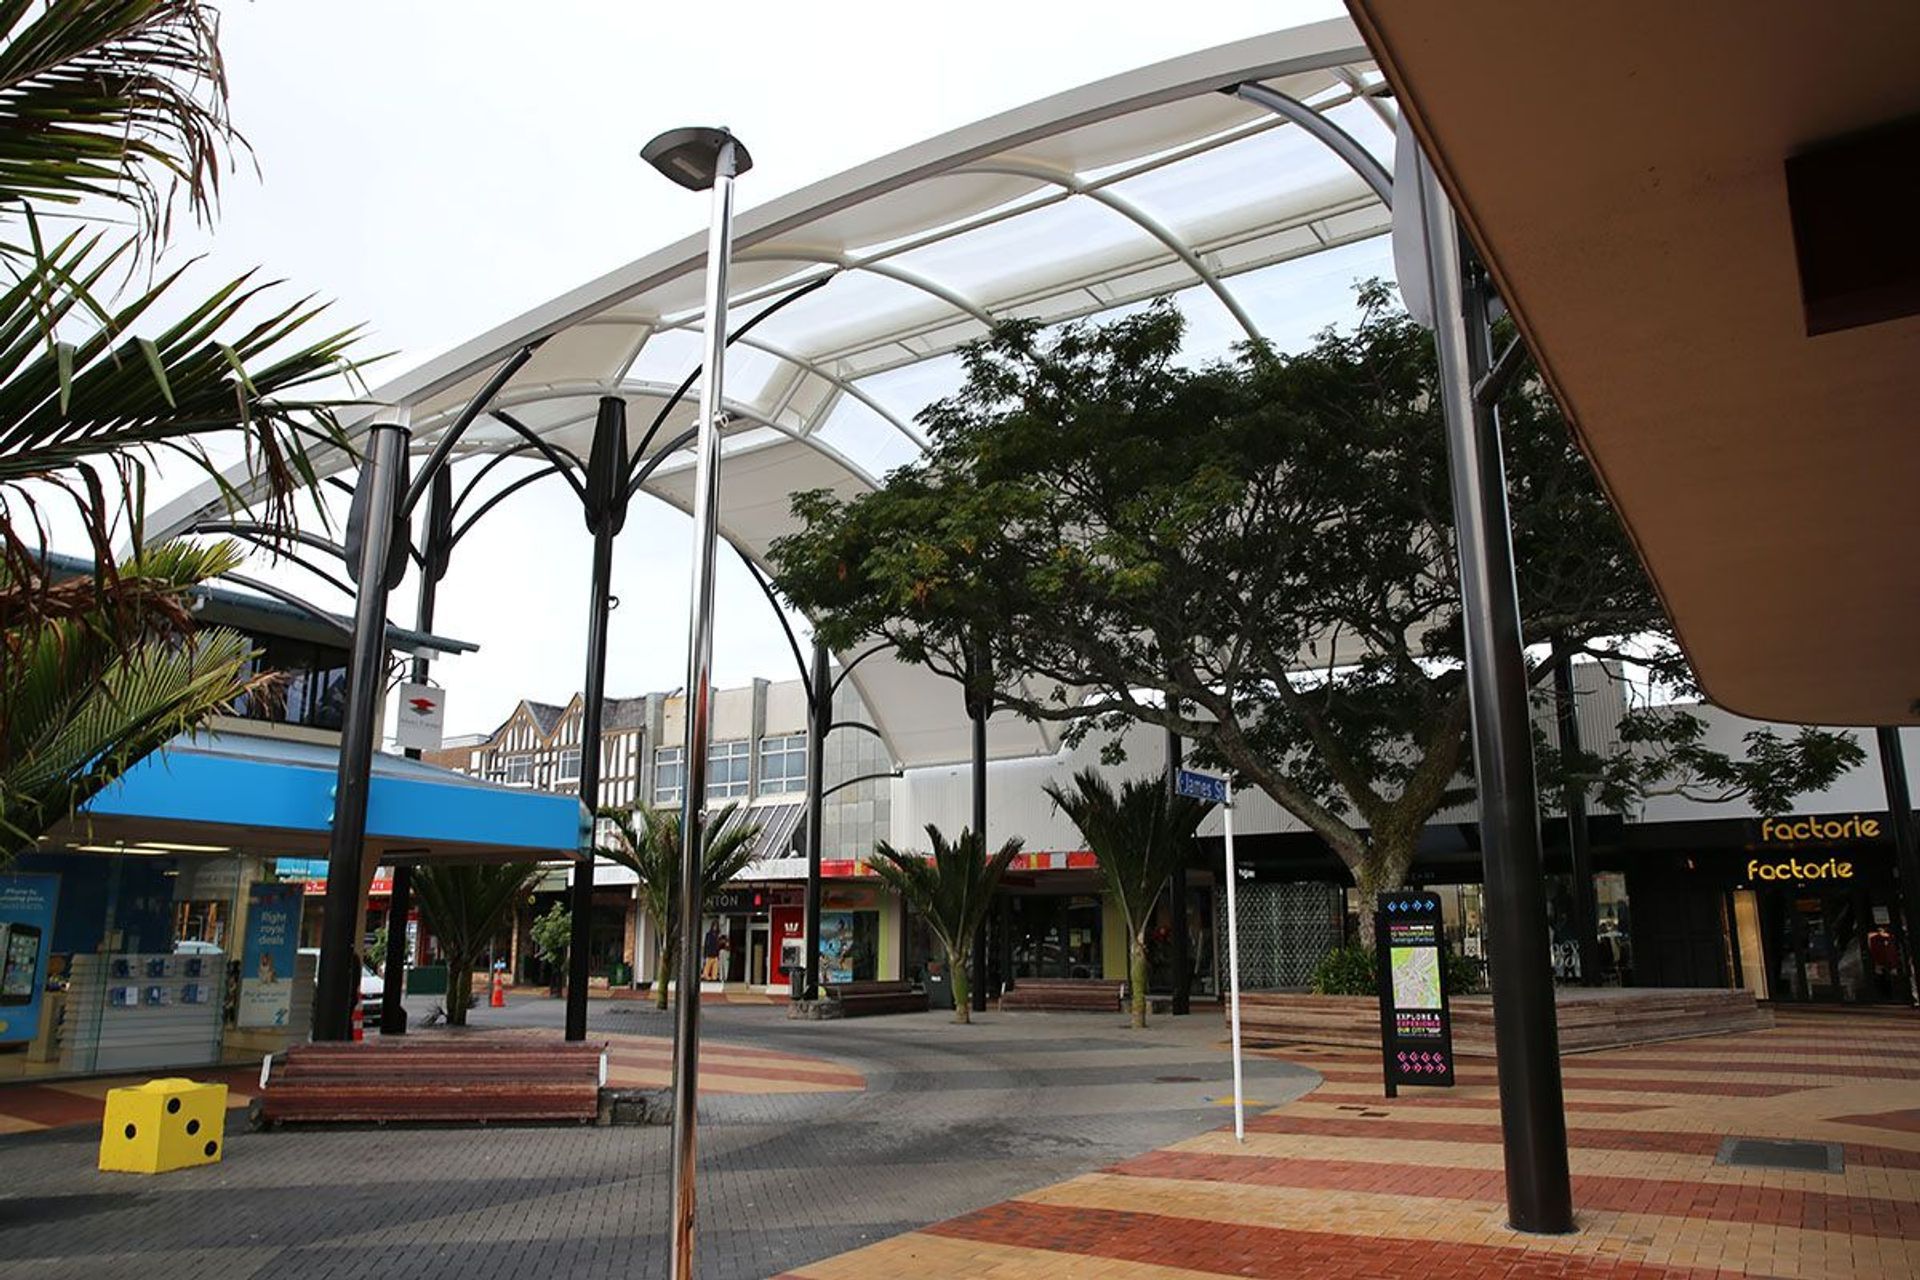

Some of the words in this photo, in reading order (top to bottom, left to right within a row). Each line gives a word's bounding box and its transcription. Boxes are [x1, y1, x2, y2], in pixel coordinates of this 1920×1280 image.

[1762, 815, 1881, 841] factorie
[1747, 858, 1854, 881] factorie
[262, 911, 287, 925] Right
[260, 923, 285, 937] royal
[258, 934, 285, 946] deals
